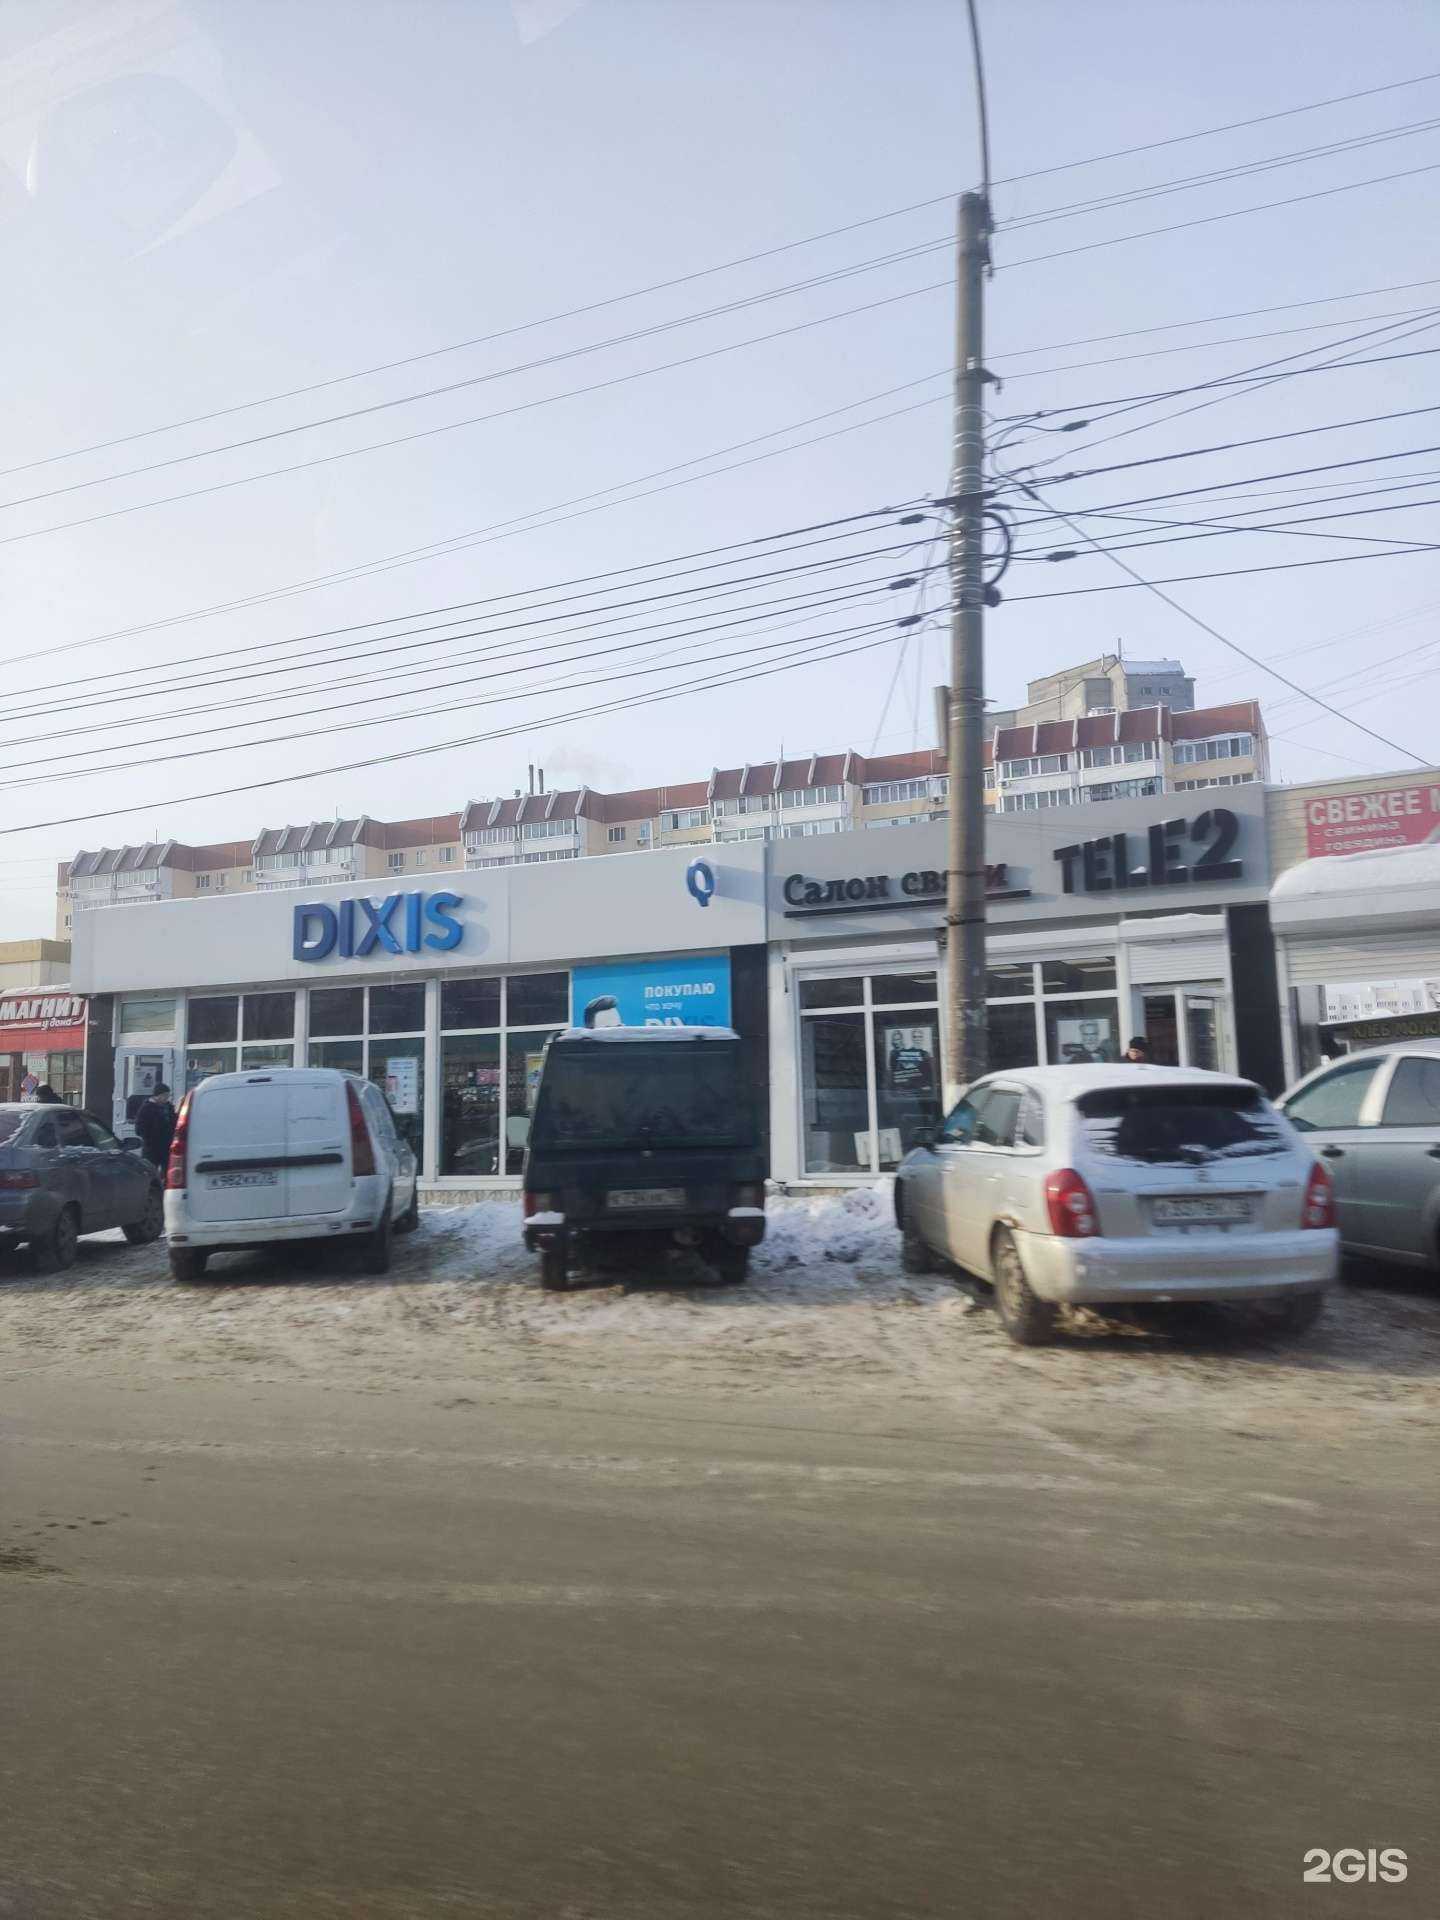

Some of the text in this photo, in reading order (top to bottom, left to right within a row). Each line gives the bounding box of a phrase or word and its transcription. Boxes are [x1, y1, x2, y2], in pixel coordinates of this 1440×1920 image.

[1310, 790, 1424, 825] СВЕЖЕЕ
[1053, 808, 1243, 894] TELE2
[784, 863, 1008, 906] Салон сви
[293, 890, 464, 961] DIXIS
[644, 982, 715, 998] ПОКУПАЮ
